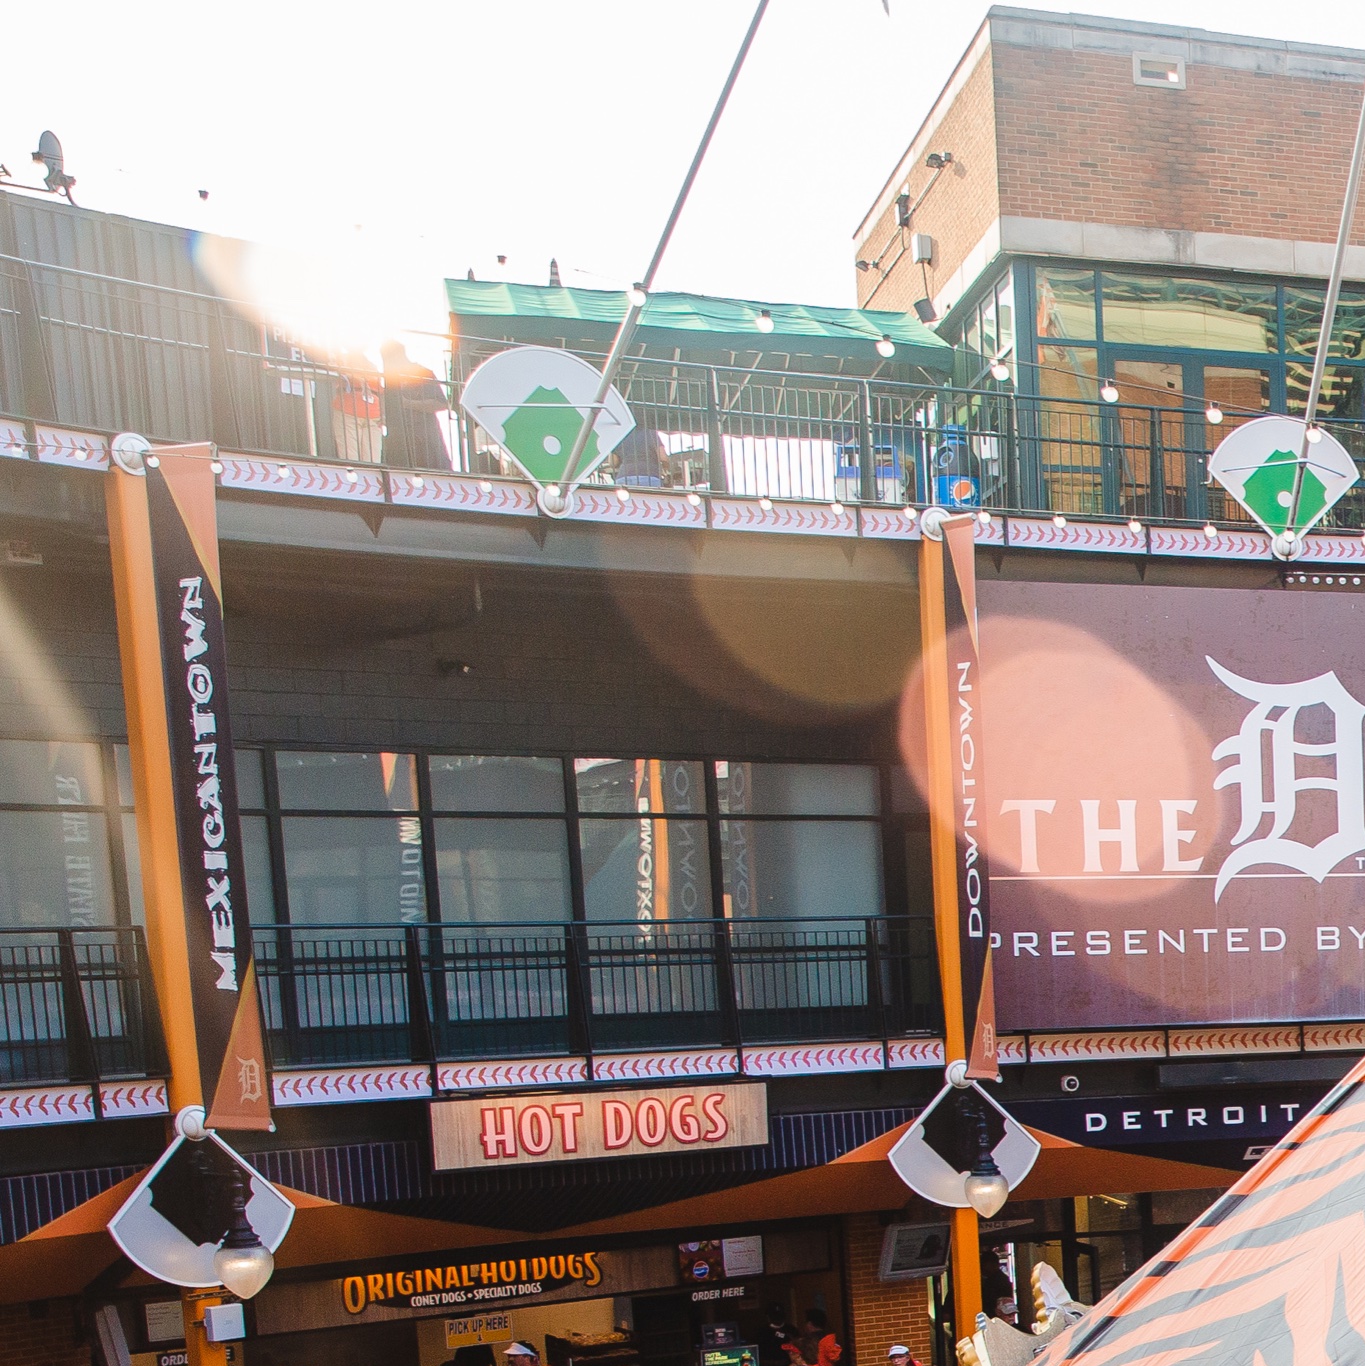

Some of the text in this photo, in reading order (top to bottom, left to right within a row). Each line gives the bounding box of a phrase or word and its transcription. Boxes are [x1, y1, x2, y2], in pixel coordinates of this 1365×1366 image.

[179, 576, 239, 991] MEXICANTOWN
[957, 661, 983, 938] DOWNTOWN
[1000, 800, 1204, 872] THE
[236, 1054, 262, 1104] D
[480, 1093, 729, 1159] HOT DOGS
[1085, 1103, 1300, 1132] DETROIT
[343, 1265, 475, 1314] ORIGINAL
[411, 1282, 542, 1308] CONEY DOGS SPECIALTY DOGS
[692, 1286, 745, 1302] ORDER HERE
[449, 1315, 509, 1336] PICK UP HERE
